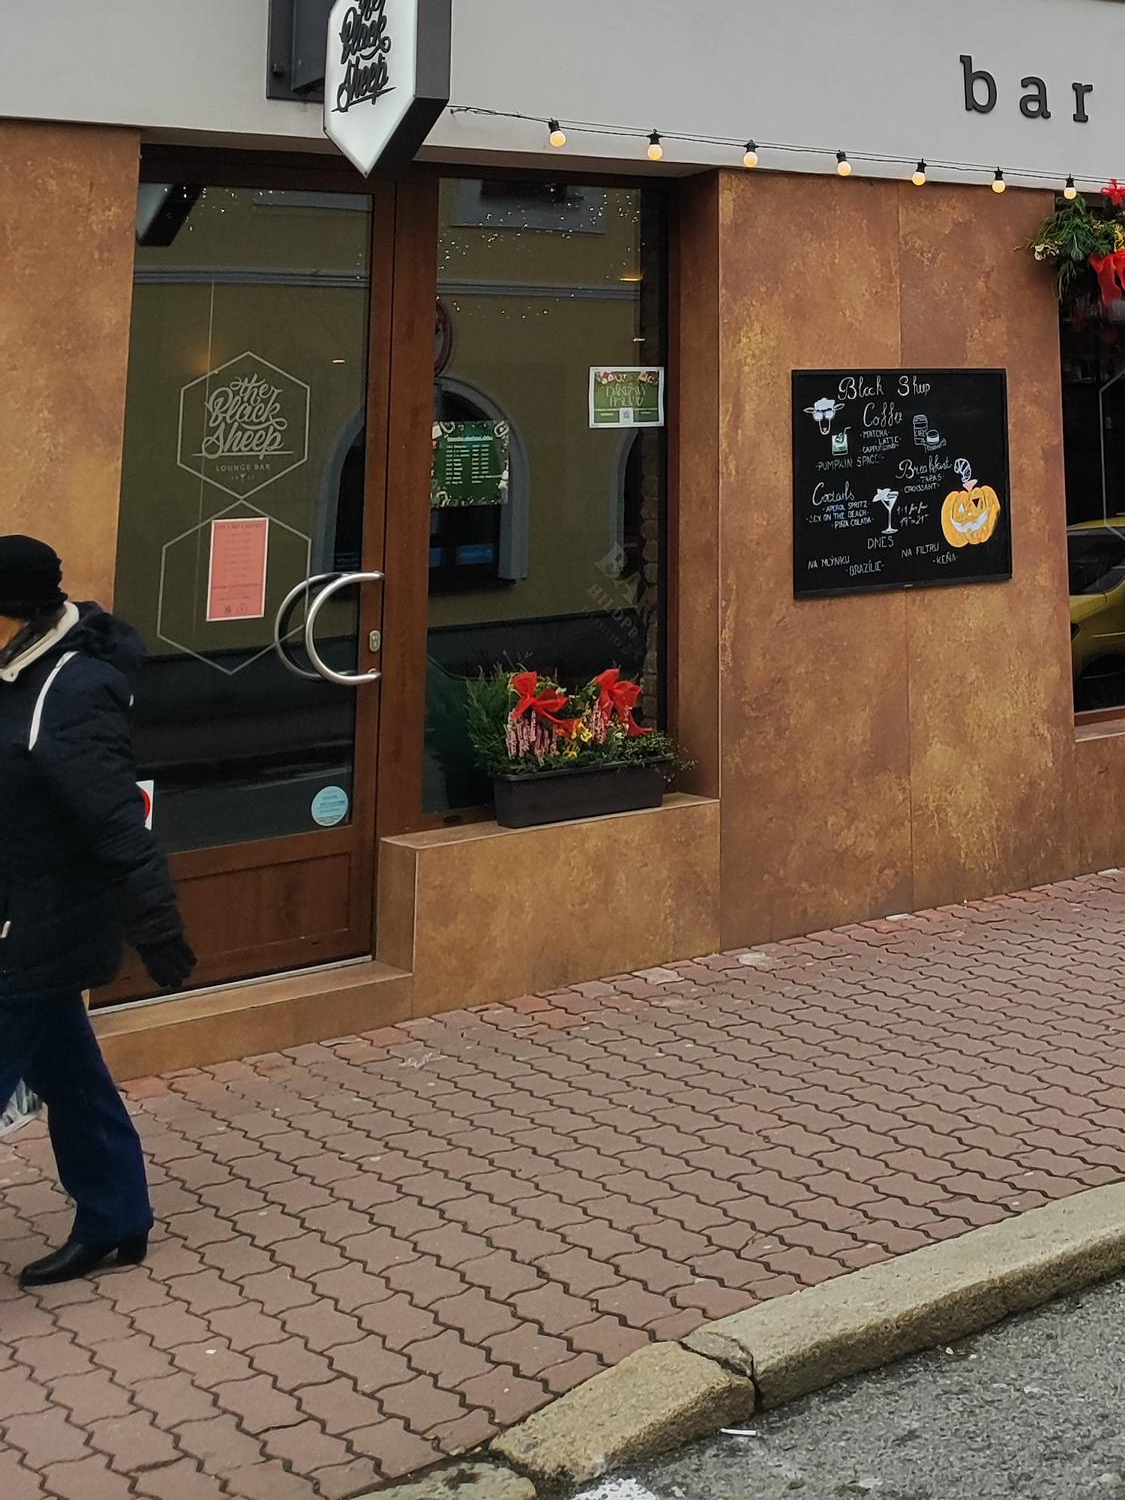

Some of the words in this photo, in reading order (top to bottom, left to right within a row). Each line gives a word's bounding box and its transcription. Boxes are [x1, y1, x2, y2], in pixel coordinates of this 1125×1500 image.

[337, 53, 389, 112] Sheep
[960, 55, 1093, 123] bar
[229, 373, 280, 406] the
[204, 387, 287, 430] Black
[202, 421, 284, 460] Sheep
[863, 430, 888, 438] MATCHA
[216, 463, 250, 472] LOUNGE
[254, 463, 271, 471] BAR
[818, 458, 853, 471] PUMPKIN
[920, 474, 942, 483] TAPAS
[904, 483, 937, 493] CROISSANT
[848, 501, 867, 509] SPRITZ
[833, 512, 845, 520] THE
[848, 510, 867, 518] BEACH
[850, 517, 872, 526] COLADA
[867, 536, 894, 550] DNES
[901, 547, 913, 558] NA
[916, 542, 940, 556] FILTRU
[807, 560, 818, 570] NA
[821, 555, 850, 567] MLÝNKU
